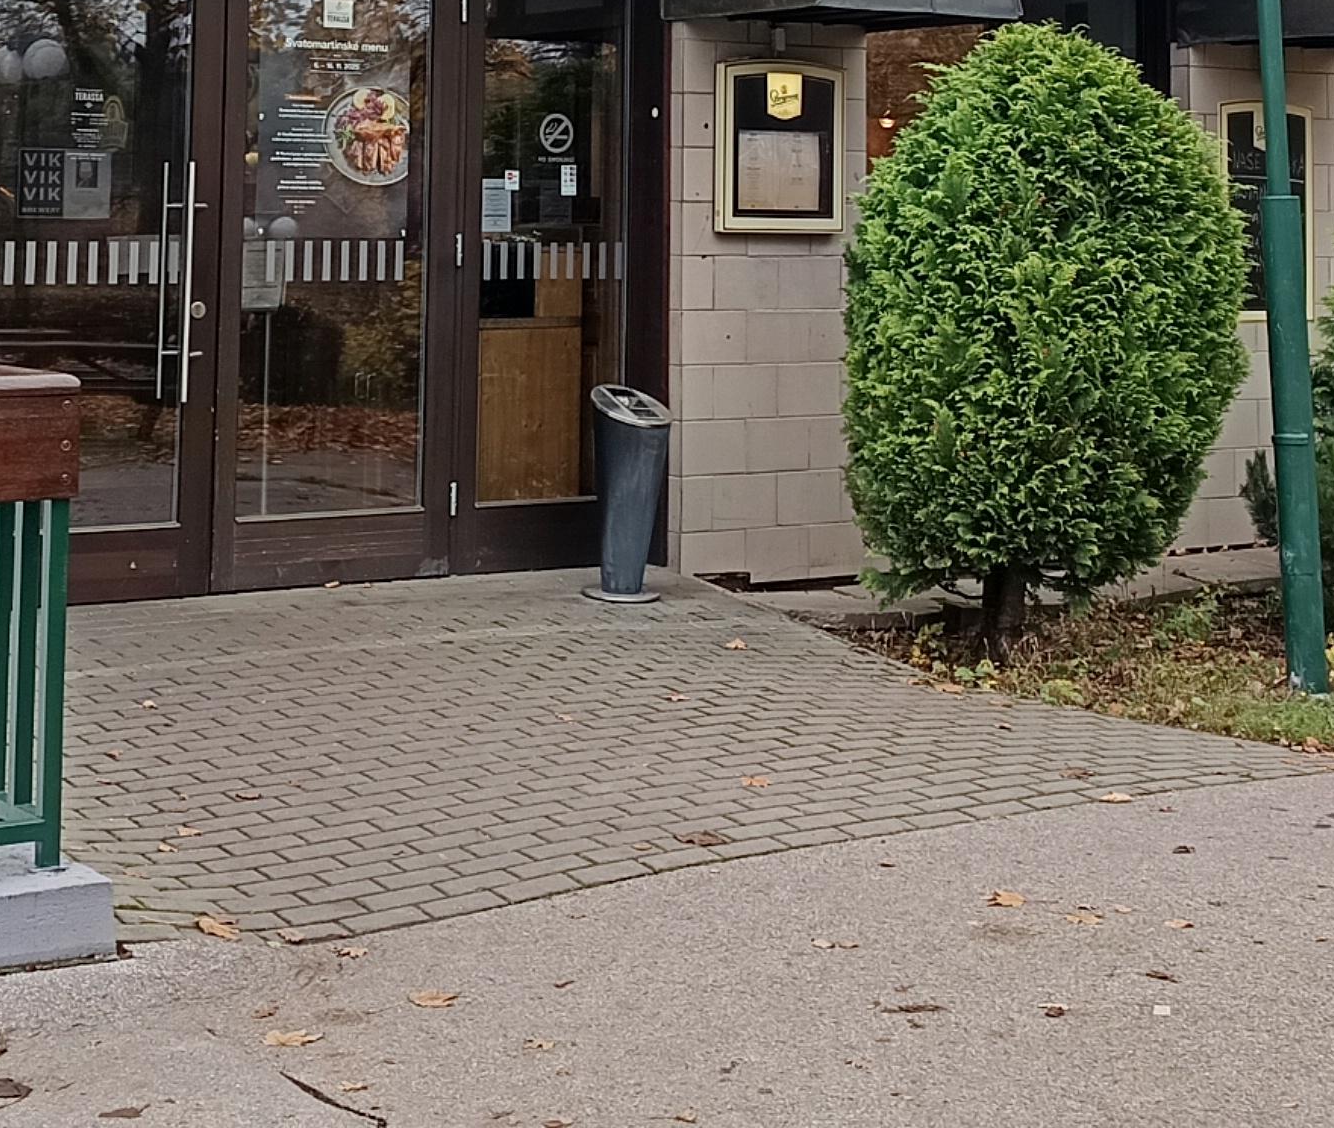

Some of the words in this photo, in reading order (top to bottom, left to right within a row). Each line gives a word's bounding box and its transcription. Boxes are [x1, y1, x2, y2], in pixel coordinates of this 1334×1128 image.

[360, 43, 389, 53] menu
[24, 153, 61, 167] VIK
[24, 171, 60, 184] VIK
[23, 187, 60, 201] VIK
